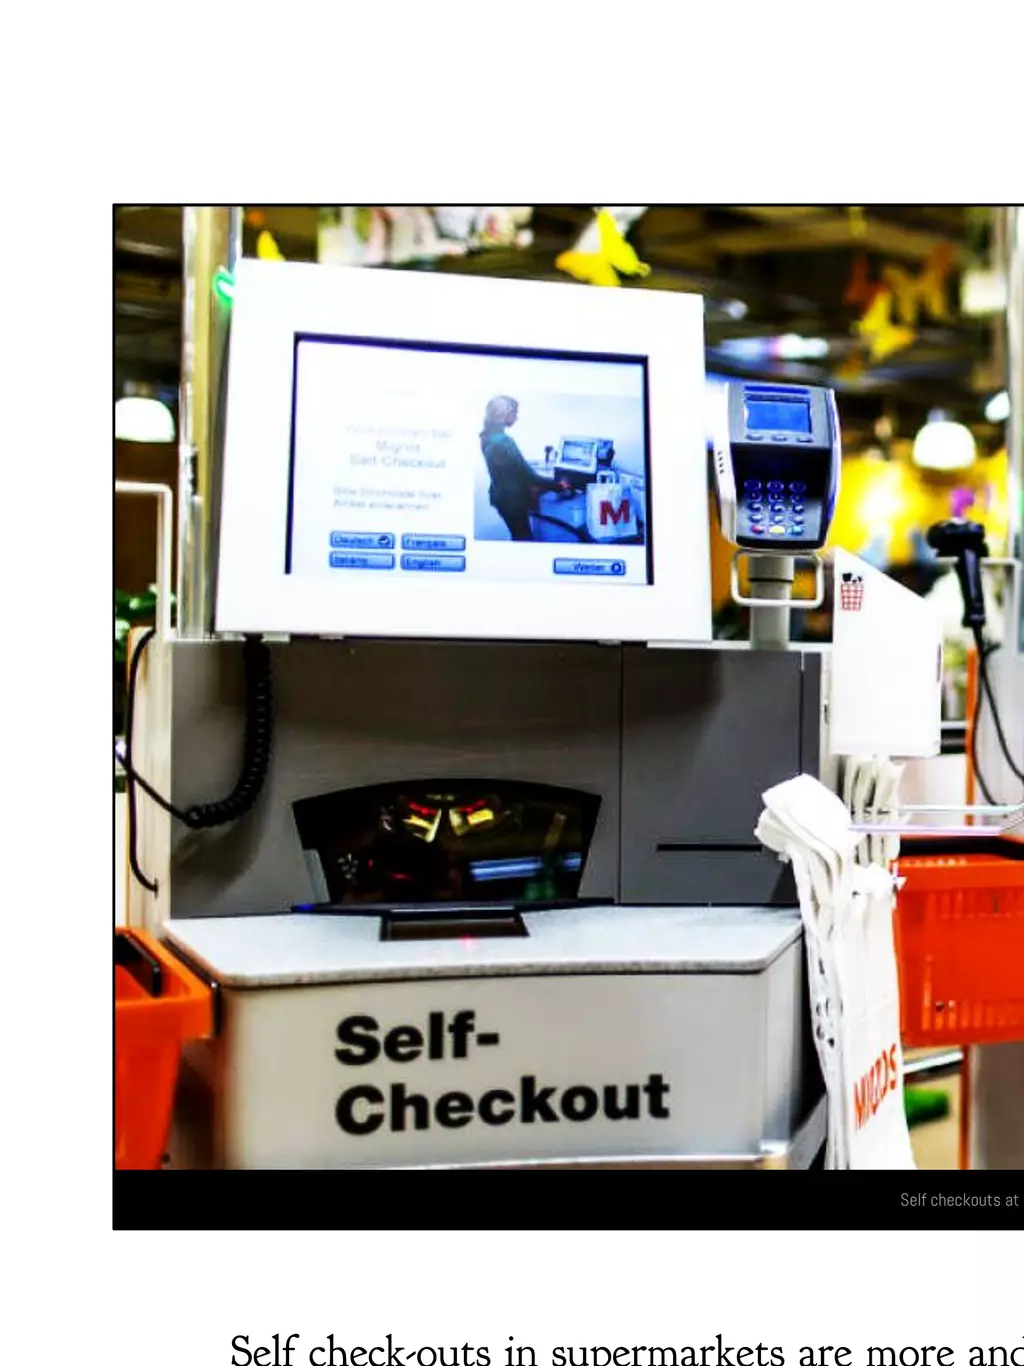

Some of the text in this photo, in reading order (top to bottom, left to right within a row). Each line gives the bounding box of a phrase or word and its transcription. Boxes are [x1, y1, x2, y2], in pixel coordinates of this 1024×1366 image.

[600, 499, 630, 526] M
[335, 1010, 499, 1065] Self-
[335, 1074, 670, 1136] Checkout
